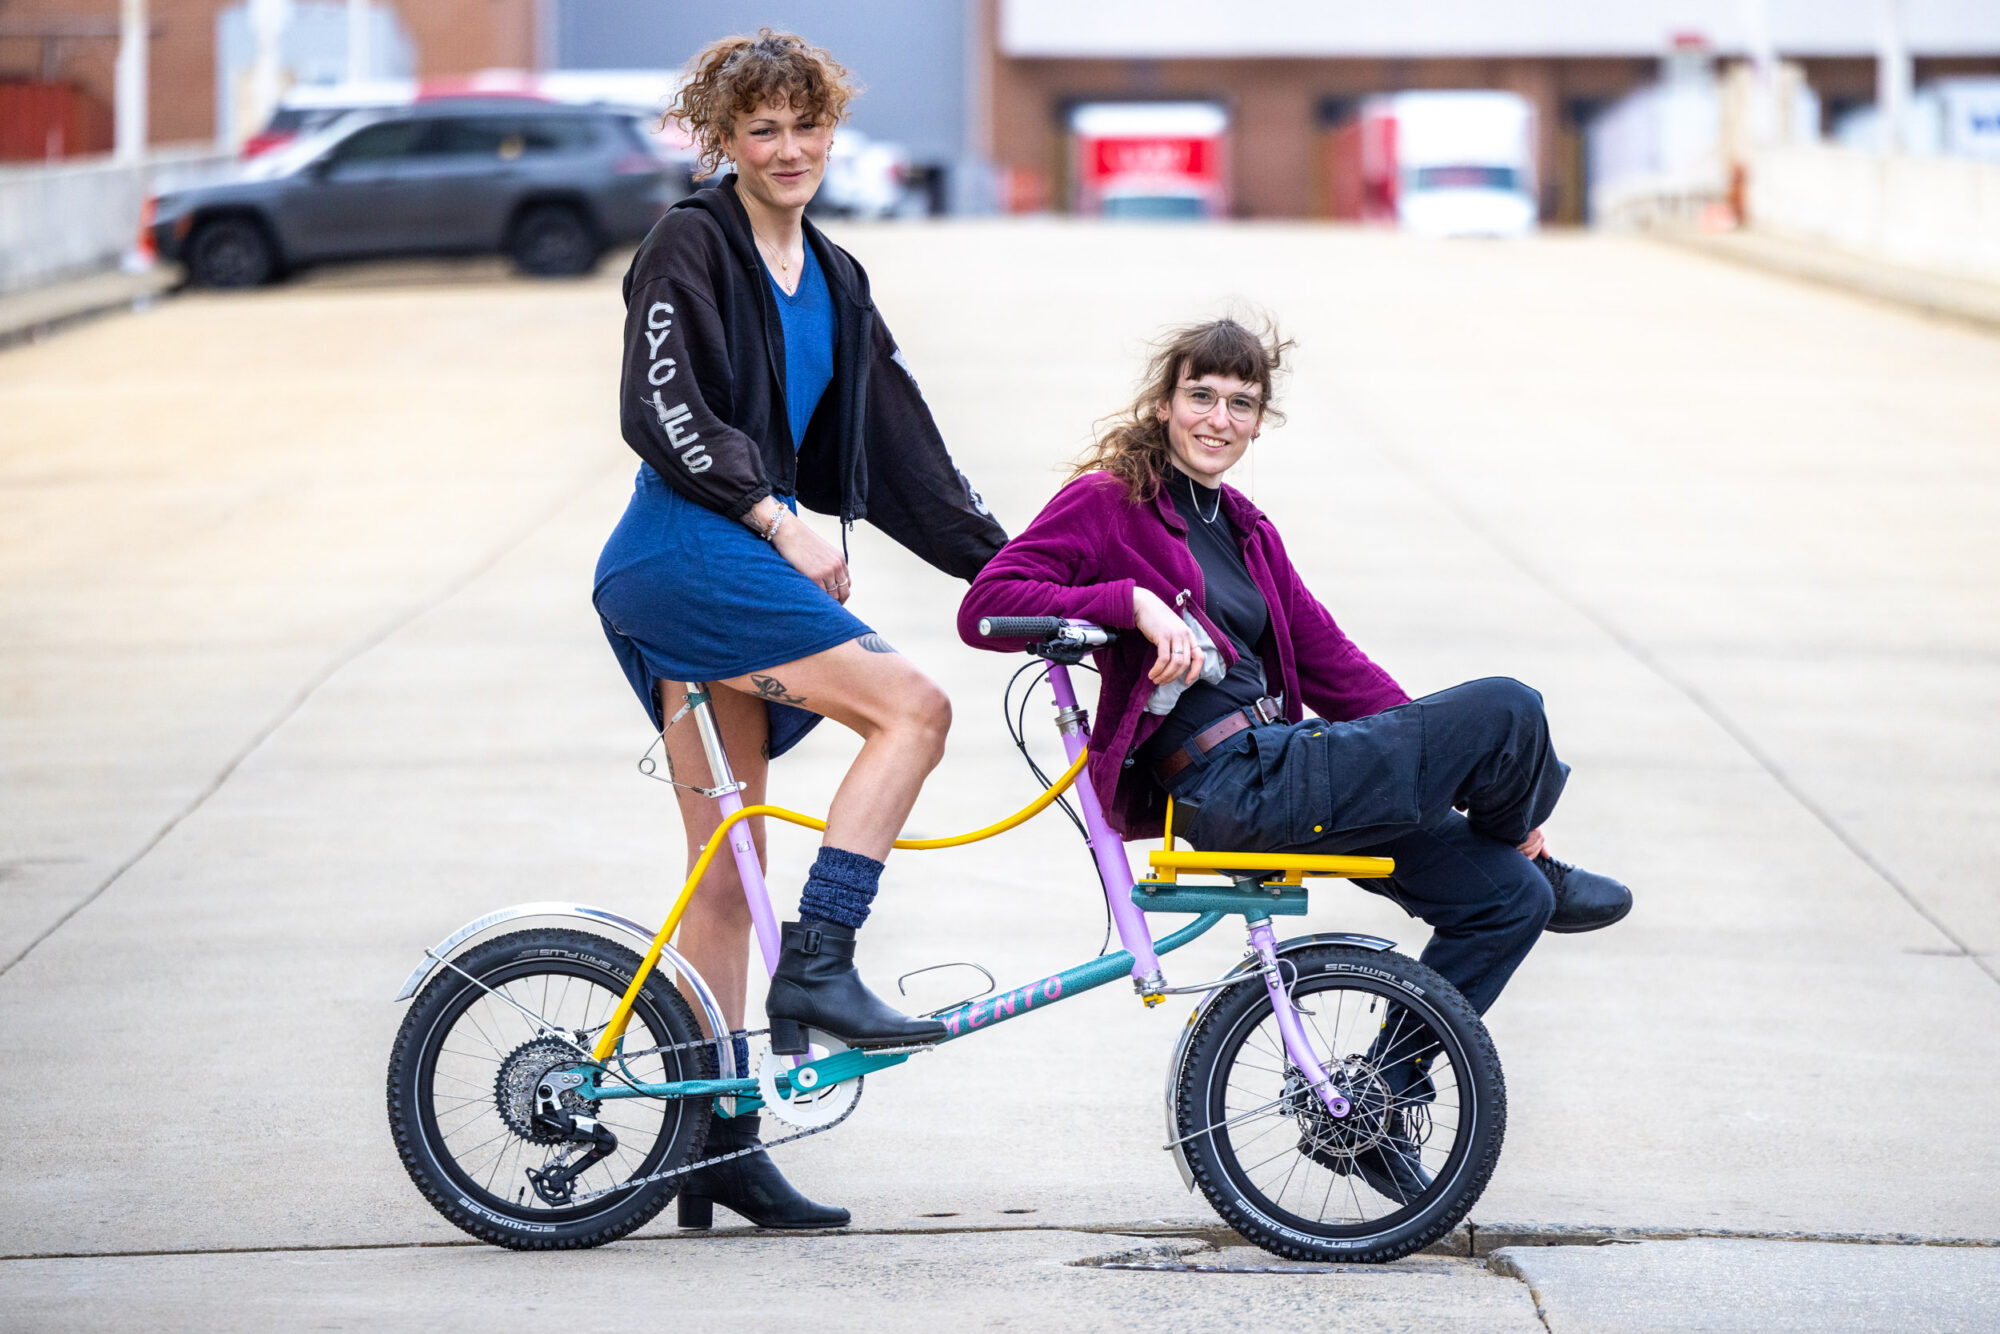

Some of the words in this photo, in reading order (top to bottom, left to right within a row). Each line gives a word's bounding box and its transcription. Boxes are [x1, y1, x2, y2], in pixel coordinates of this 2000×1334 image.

[645, 301, 713, 474] CYCLES
[540, 949, 578, 960] PLUS
[580, 954, 612, 969] SAM
[1324, 963, 1426, 997] SCHWALBE
[458, 1197, 557, 1233] SCHWALBE
[1235, 1198, 1280, 1231] SMART
[1279, 1229, 1311, 1244] SAM
[1312, 1239, 1352, 1249] PLUS
